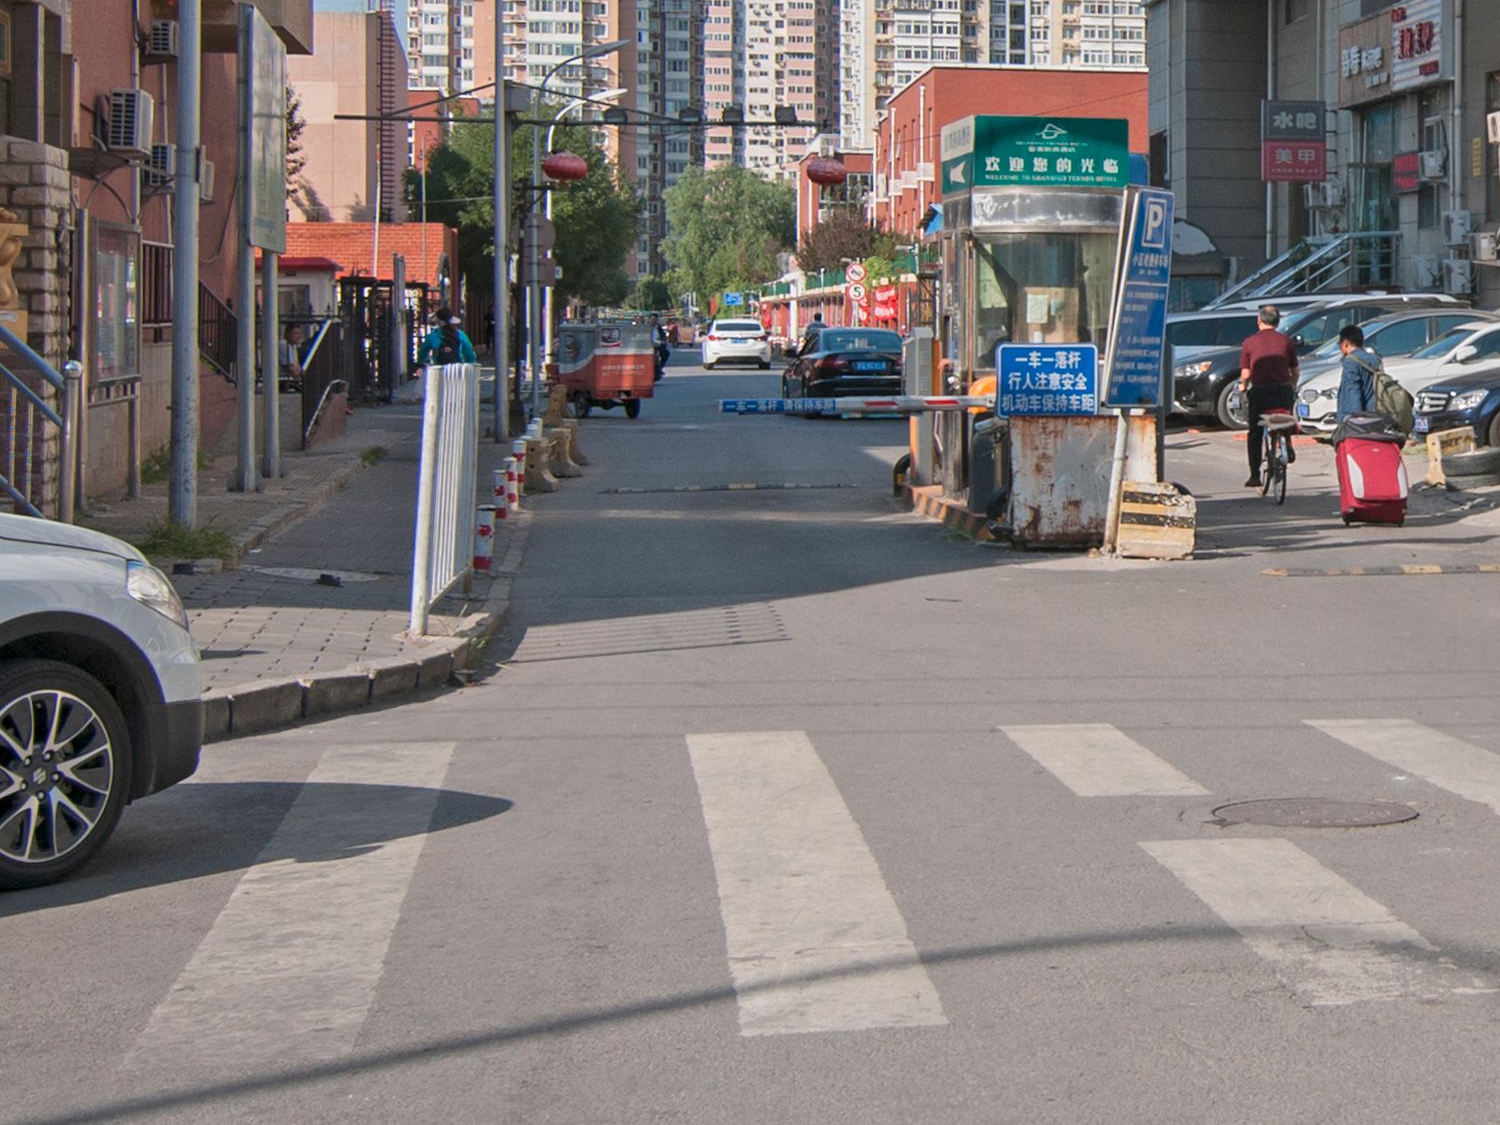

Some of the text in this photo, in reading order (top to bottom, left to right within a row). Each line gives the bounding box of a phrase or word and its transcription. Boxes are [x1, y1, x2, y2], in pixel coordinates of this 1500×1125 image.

[1272, 111, 1317, 129] 水吧
[985, 156, 1119, 174] 欢迎您的光临
[1274, 148, 1316, 165] 美甲
[1146, 204, 1163, 241] P
[853, 286, 862, 298] 5
[1015, 350, 1081, 369] 一车一落杆
[1007, 372, 1087, 390] 行人注意安全
[1001, 394, 1095, 412] 机动车保持车距
